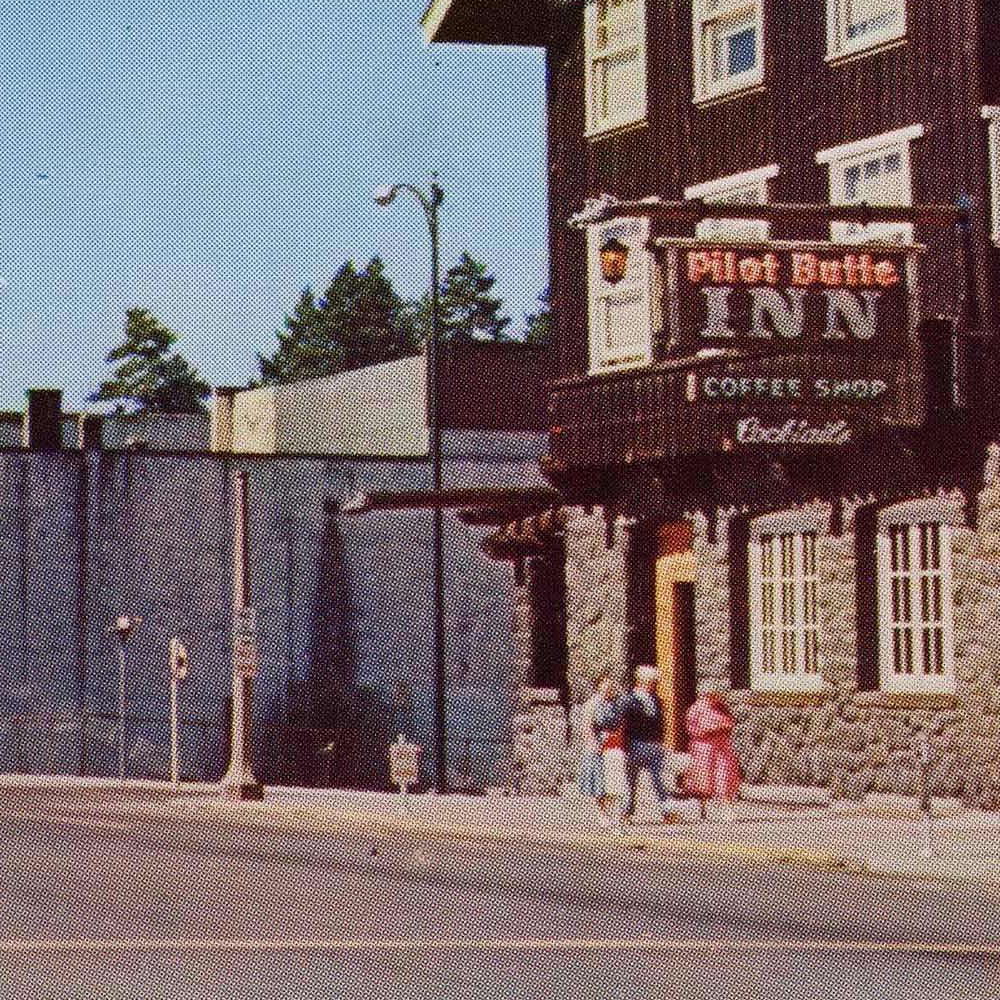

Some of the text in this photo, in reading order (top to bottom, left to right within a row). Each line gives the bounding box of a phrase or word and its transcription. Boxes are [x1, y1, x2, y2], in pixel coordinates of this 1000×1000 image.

[688, 250, 900, 287] Pilot Butte
[700, 287, 882, 339] INN
[703, 377, 888, 399] COFFEE SHOP
[736, 416, 852, 446] Cocktails
